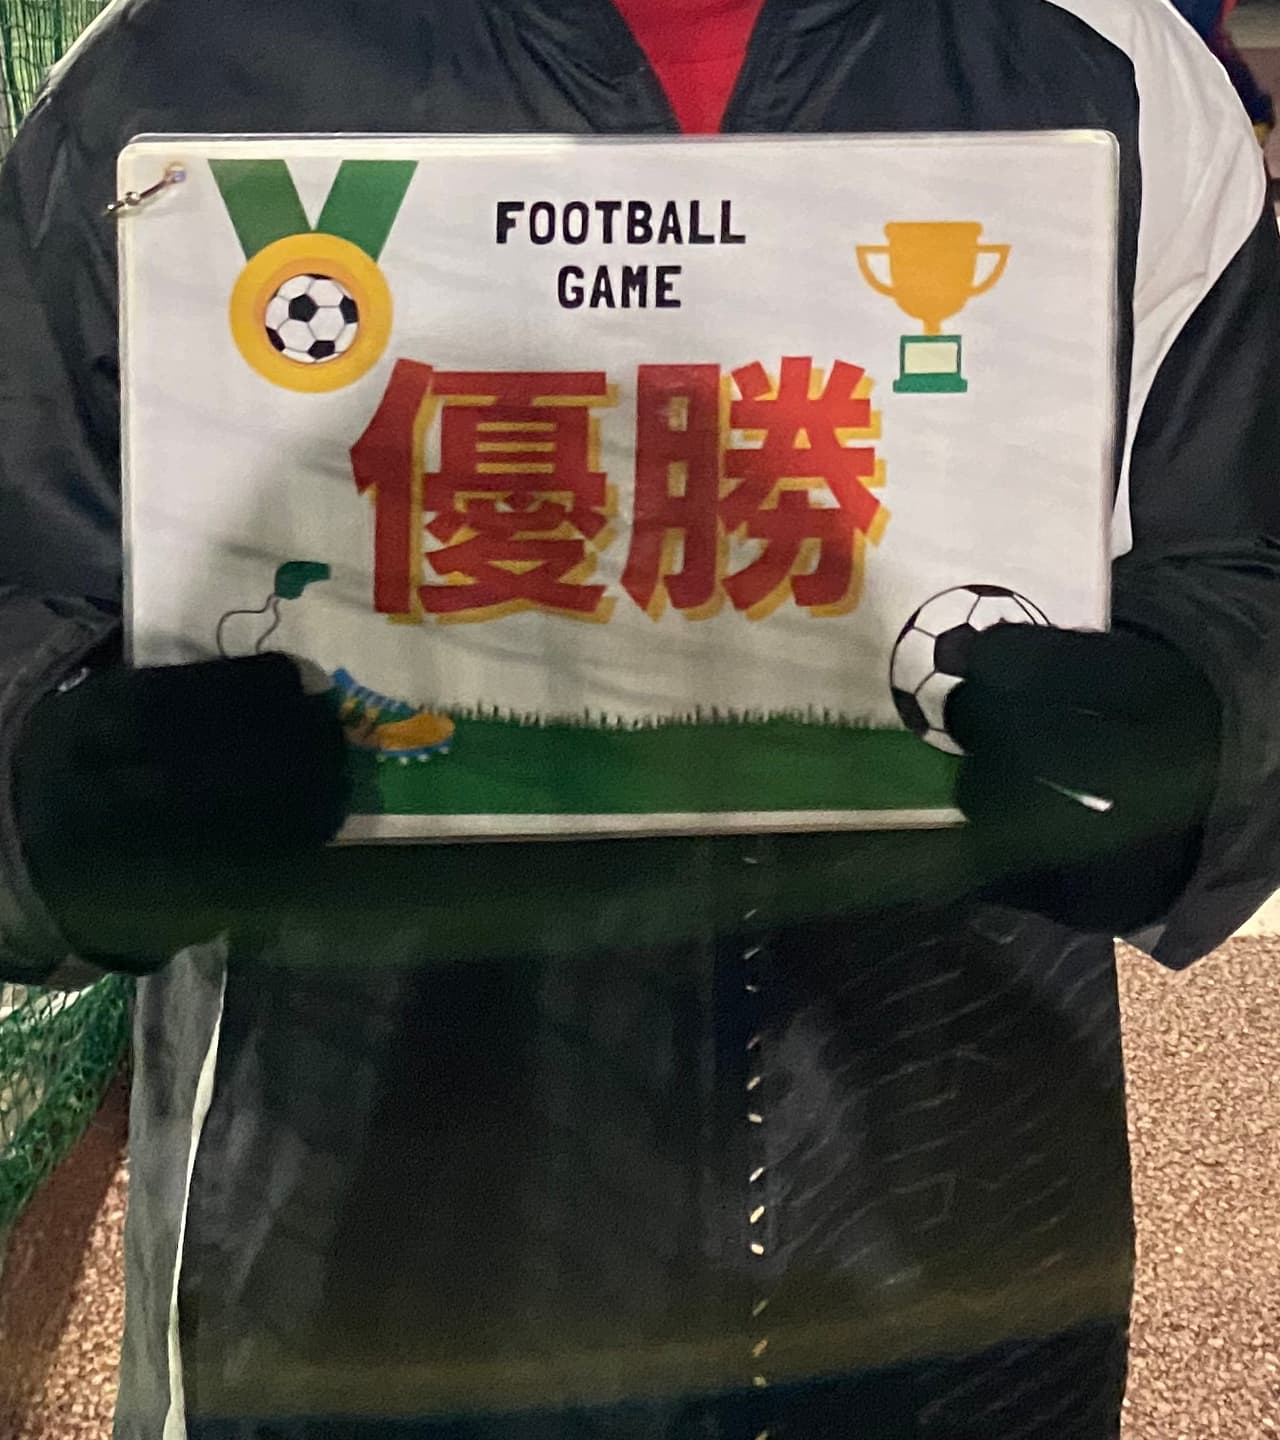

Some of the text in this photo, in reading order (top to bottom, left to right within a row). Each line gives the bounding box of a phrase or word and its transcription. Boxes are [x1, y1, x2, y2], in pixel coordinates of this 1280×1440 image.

[496, 199, 746, 245] FOOTBALL
[557, 265, 682, 309] GAME
[350, 356, 892, 624] 優勝
